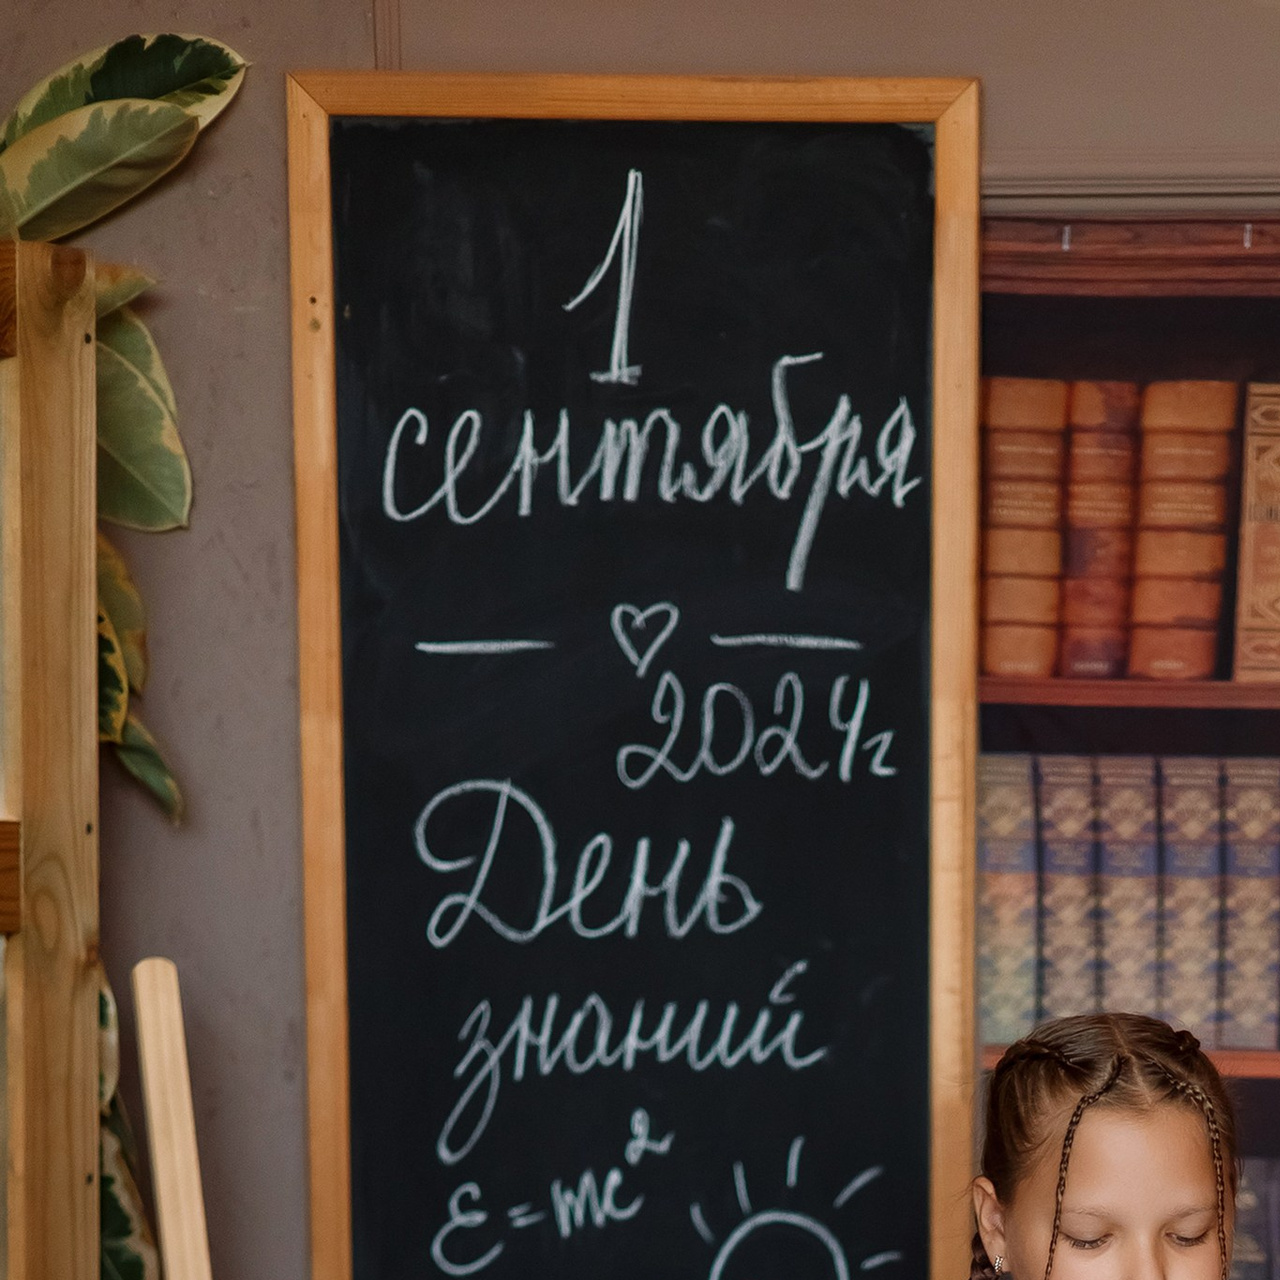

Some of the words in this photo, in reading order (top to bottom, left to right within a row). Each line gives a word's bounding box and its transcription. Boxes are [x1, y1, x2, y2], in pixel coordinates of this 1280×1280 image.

[563, 169, 642, 384] 1
[384, 352, 922, 590] сентября
[414, 779, 764, 948] День
[438, 961, 830, 1165] знаний
